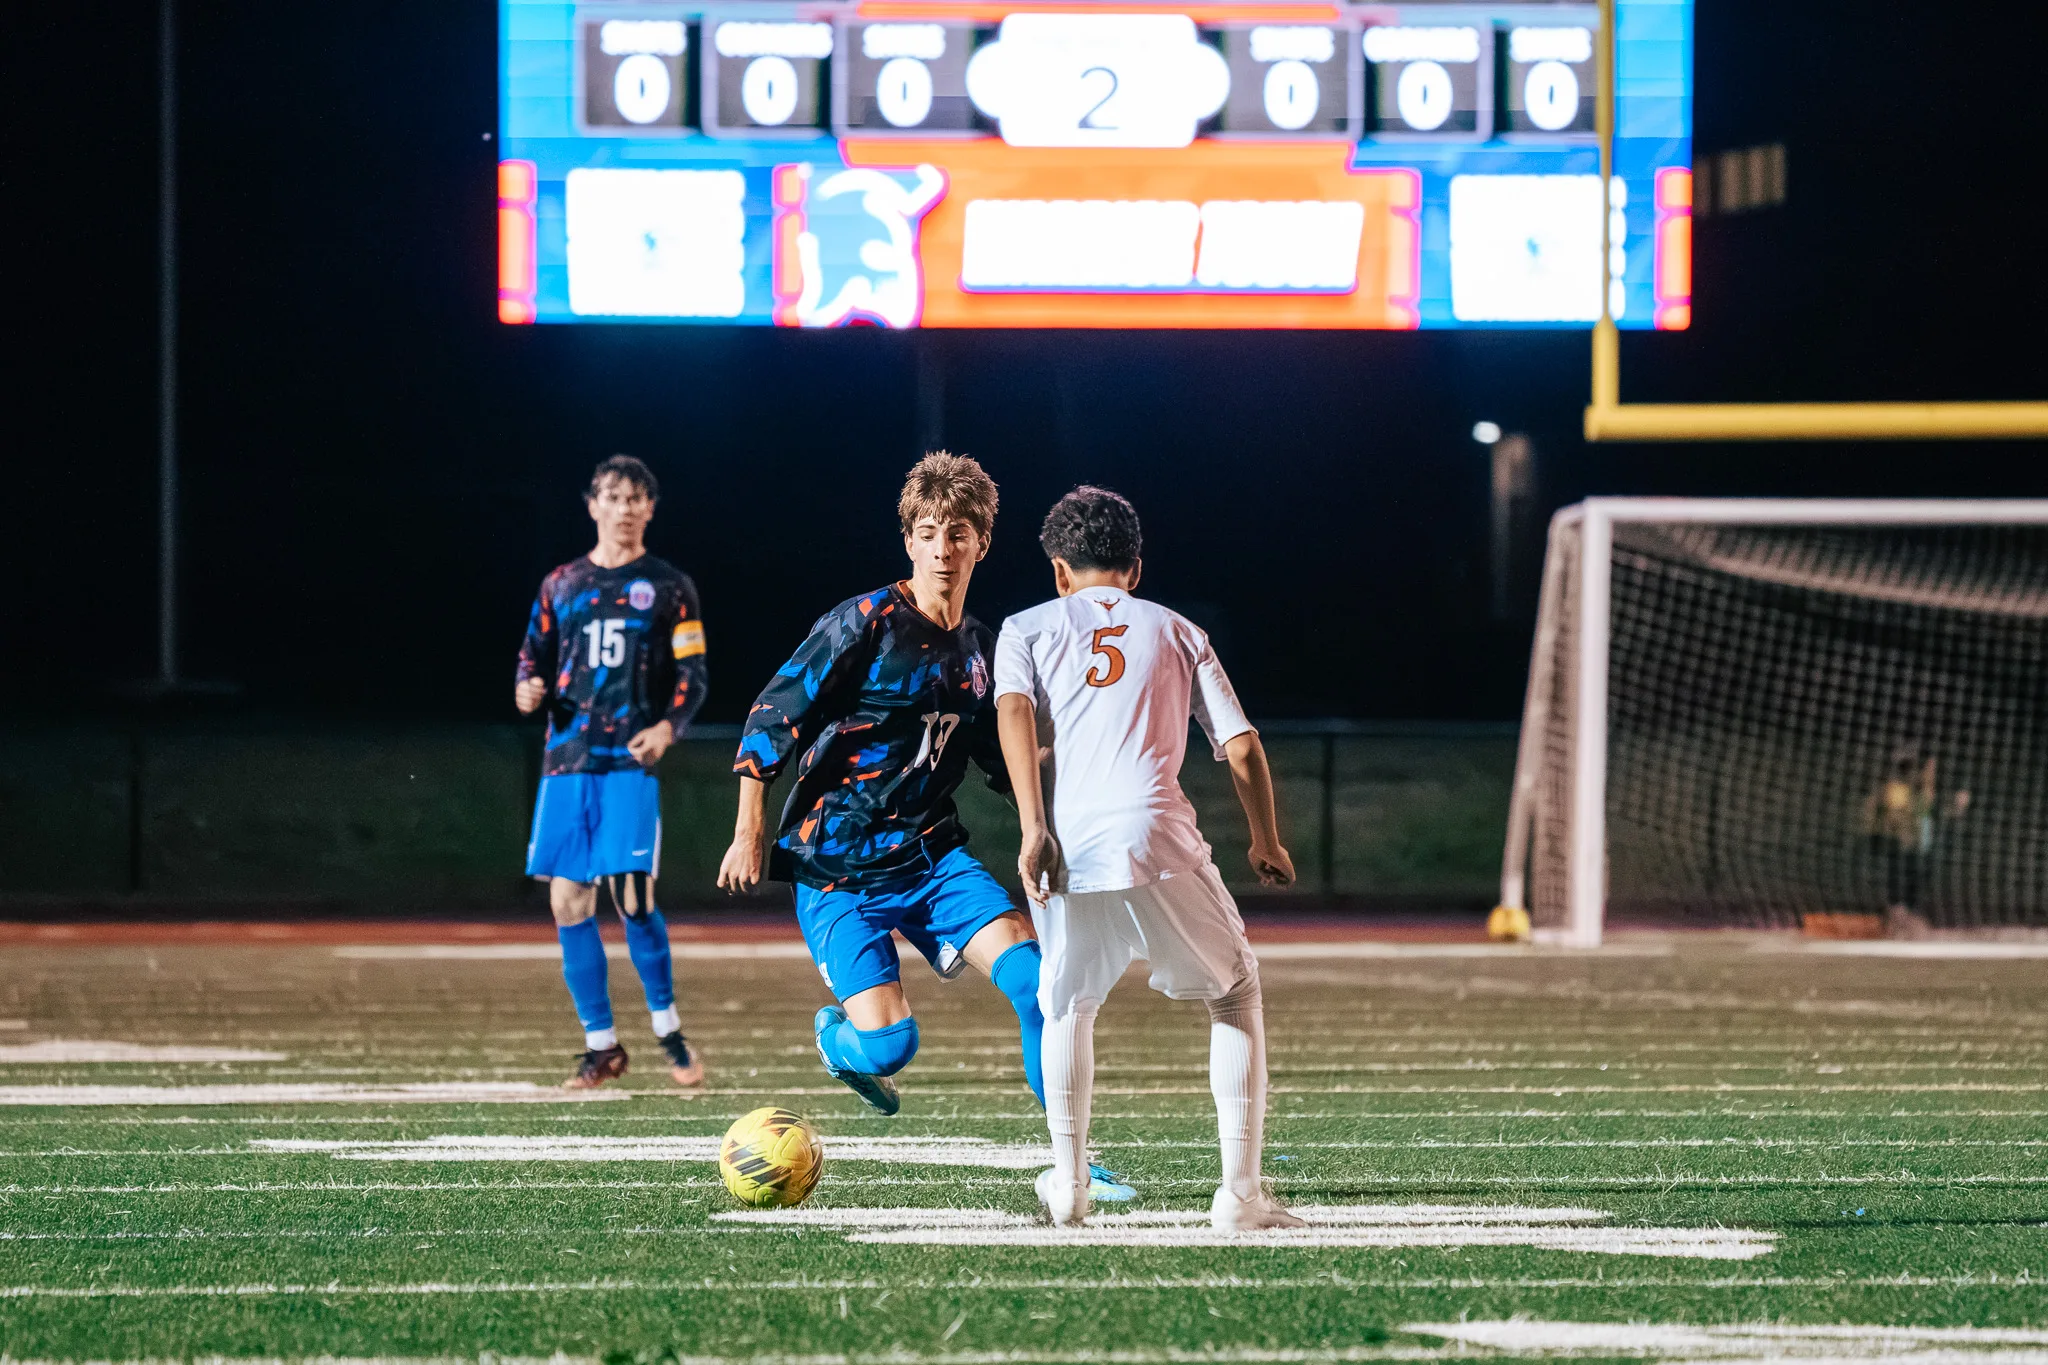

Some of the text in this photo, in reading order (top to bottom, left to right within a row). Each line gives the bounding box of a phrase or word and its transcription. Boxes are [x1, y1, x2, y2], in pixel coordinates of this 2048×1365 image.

[615, 54, 670, 123] 0
[742, 56, 797, 125] 0
[877, 57, 933, 126] 0
[1078, 66, 1119, 129] 2
[1264, 60, 1319, 130] 0
[1398, 60, 1453, 130] 0
[1524, 61, 1579, 130] 0
[583, 618, 626, 669] 15
[1086, 624, 1129, 688] 5
